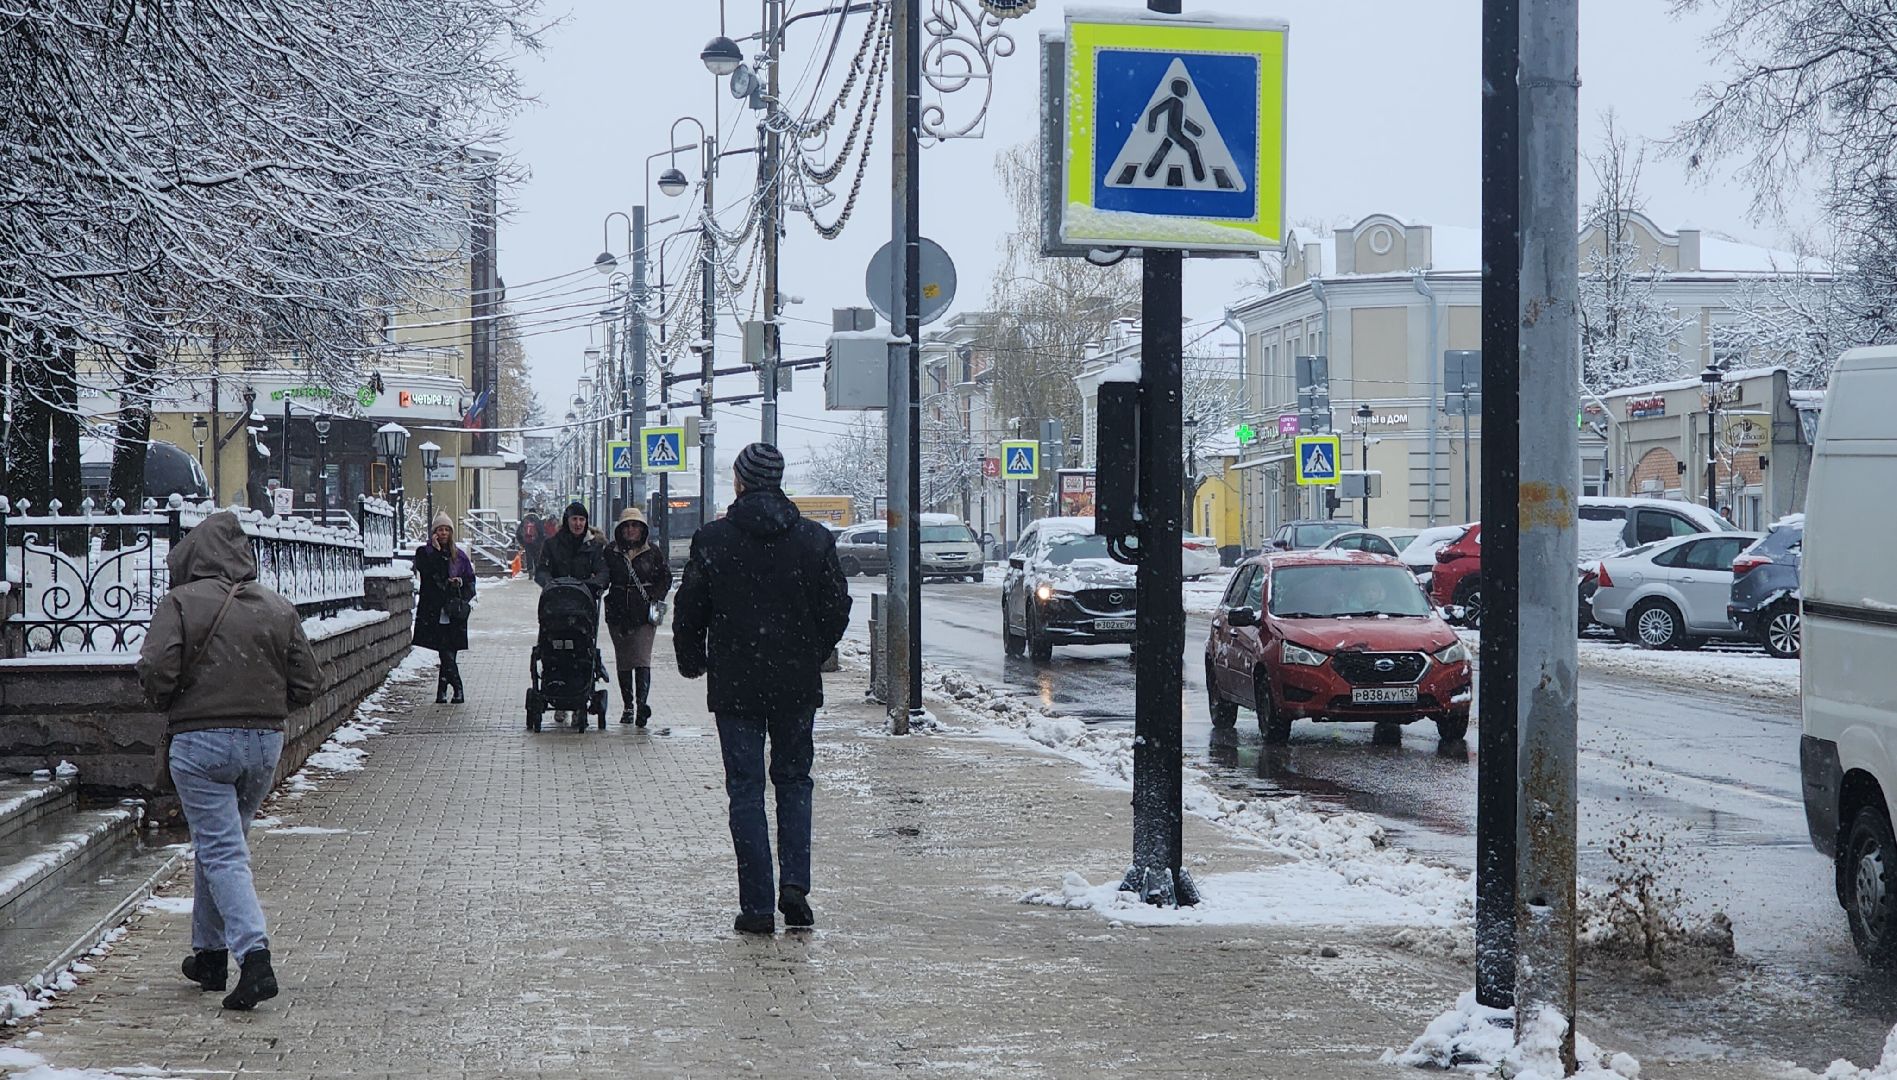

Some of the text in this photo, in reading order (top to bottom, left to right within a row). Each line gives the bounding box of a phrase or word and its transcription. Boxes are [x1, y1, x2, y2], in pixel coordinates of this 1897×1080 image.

[1386, 414, 1408, 425] ДОМ
[1355, 688, 1415, 701] Р838АУ 152
